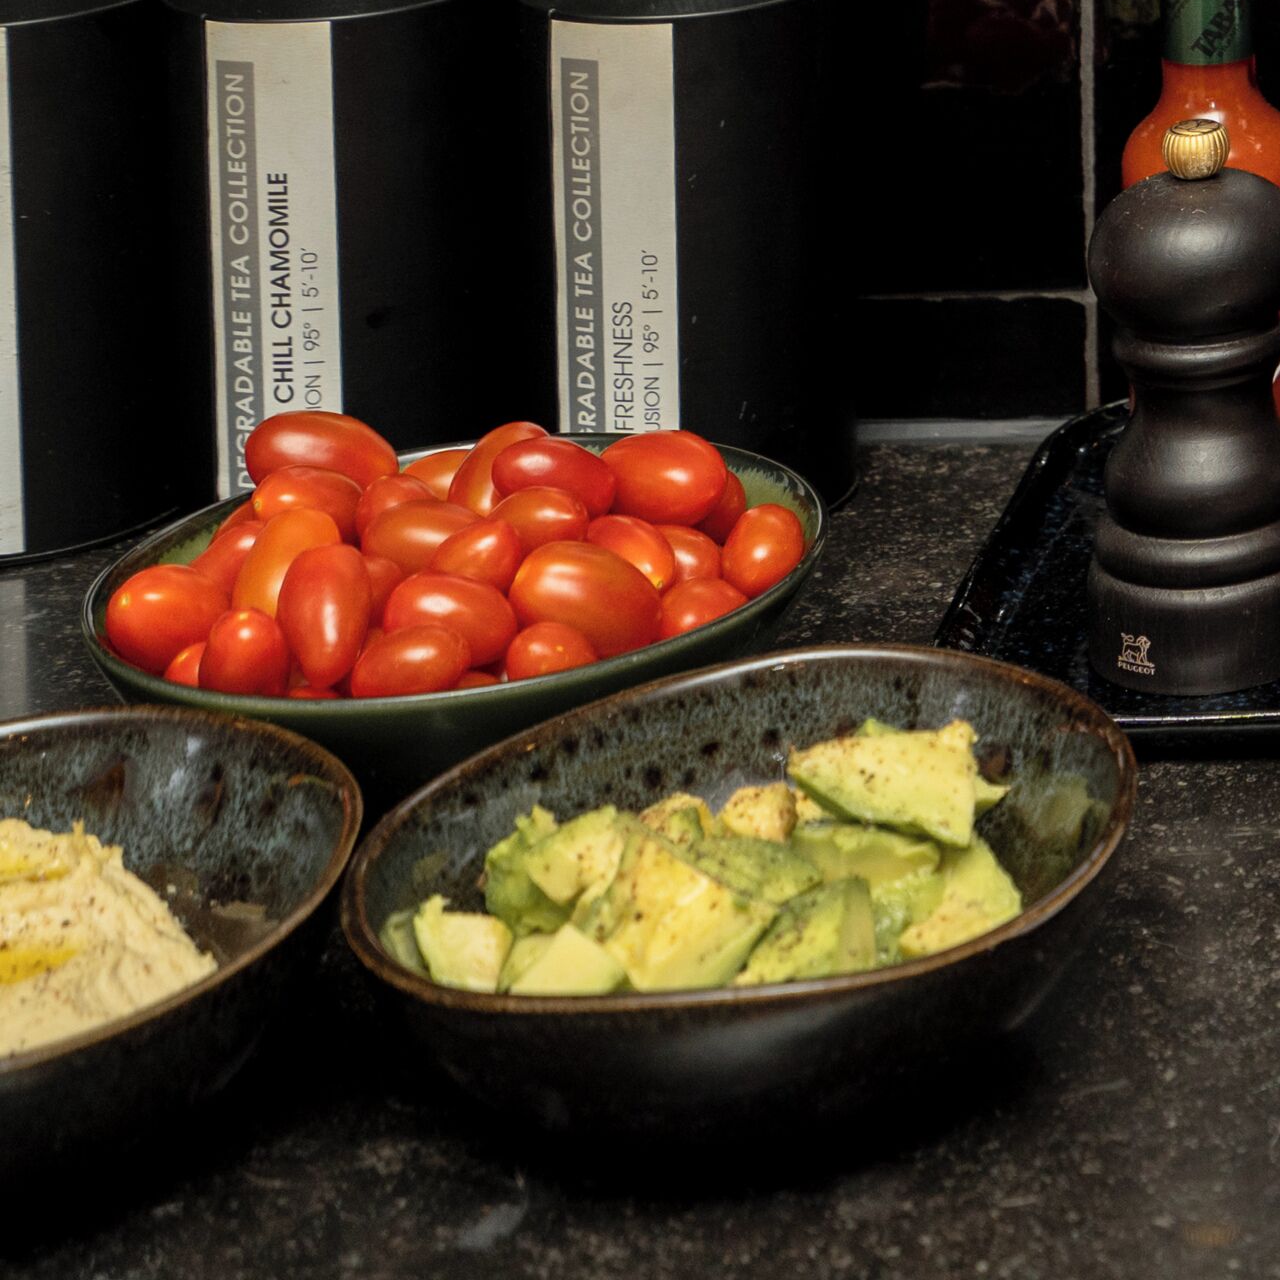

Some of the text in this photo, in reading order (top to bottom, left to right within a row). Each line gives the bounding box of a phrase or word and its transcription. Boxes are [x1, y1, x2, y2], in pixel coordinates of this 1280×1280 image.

[224, 73, 249, 245] COLLECTION
[230, 255, 252, 302] TEA
[266, 172, 294, 404] CHILL CHAMOMILE
[569, 71, 597, 433] RADABLE TEA COLLECTION
[611, 301, 635, 431] FRESHNESS
[643, 376, 661, 433] USION
[1117, 660, 1156, 676] PEUGEOT
